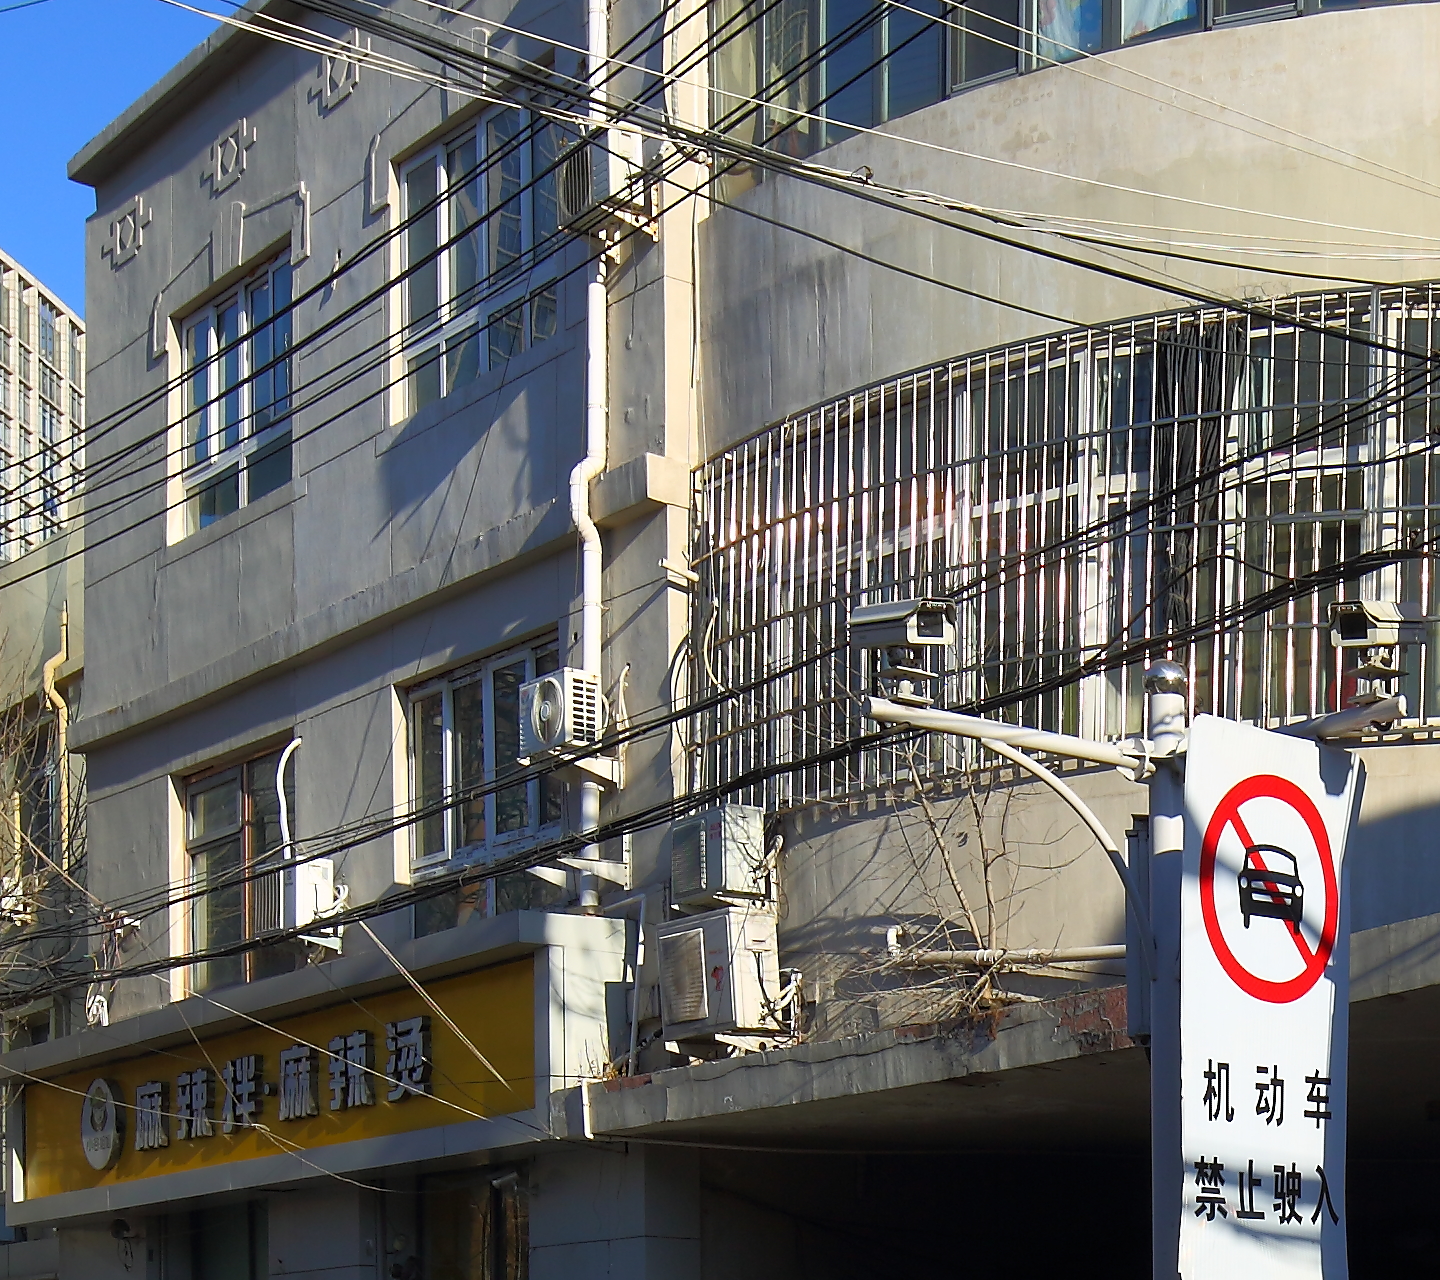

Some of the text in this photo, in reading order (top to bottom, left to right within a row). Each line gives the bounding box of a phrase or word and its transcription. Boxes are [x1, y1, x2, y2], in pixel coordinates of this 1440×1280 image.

[134, 1016, 432, 1152] 麻辣拌·麻辣烫
[1202, 1058, 1332, 1129] 机动车
[1193, 1155, 1340, 1226] 禁止驶入
